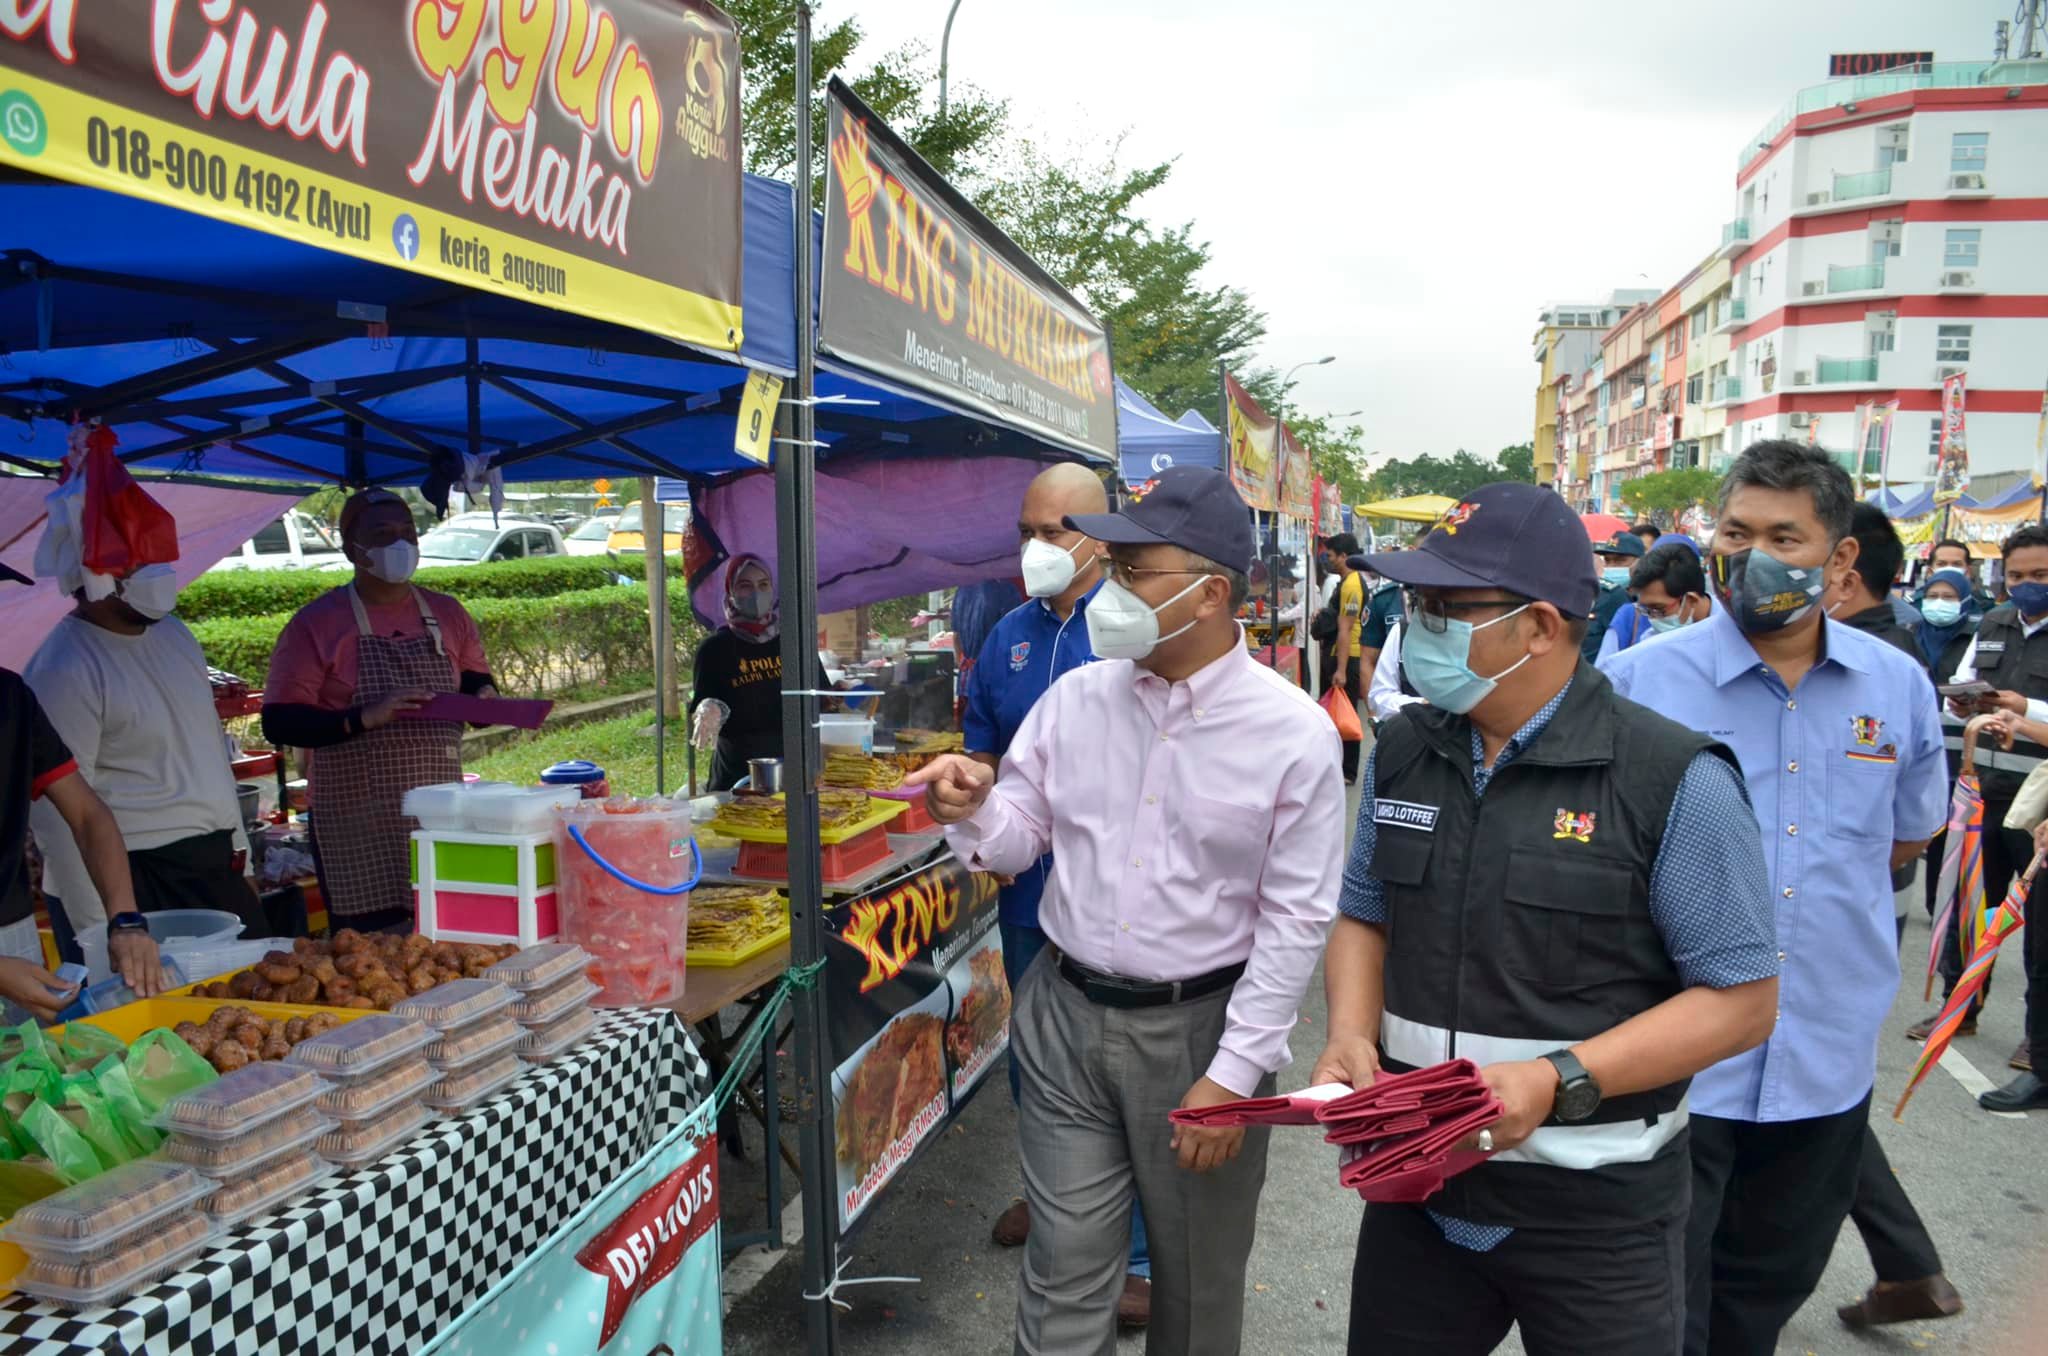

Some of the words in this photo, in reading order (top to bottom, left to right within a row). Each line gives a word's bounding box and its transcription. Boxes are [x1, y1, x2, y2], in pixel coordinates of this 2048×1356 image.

[150, 0, 371, 168] Gula
[685, 93, 713, 129] Keria
[87, 115, 228, 203] 018-900
[234, 163, 301, 223] 4192
[306, 185, 372, 242] (Ayu)
[407, 65, 633, 257] Melaka
[675, 106, 729, 162] Anggun
[439, 226, 567, 297] keria_anggun
[843, 160, 957, 326] KING
[965, 238, 1097, 406] MURTABAK
[904, 328, 959, 382] Menerima
[749, 408, 763, 442] 9
[1395, 806, 1434, 825] LOTFFEE
[857, 864, 960, 993] KING
[846, 1155, 889, 1217] Murtabak
[914, 1092, 945, 1137] RM6.00
